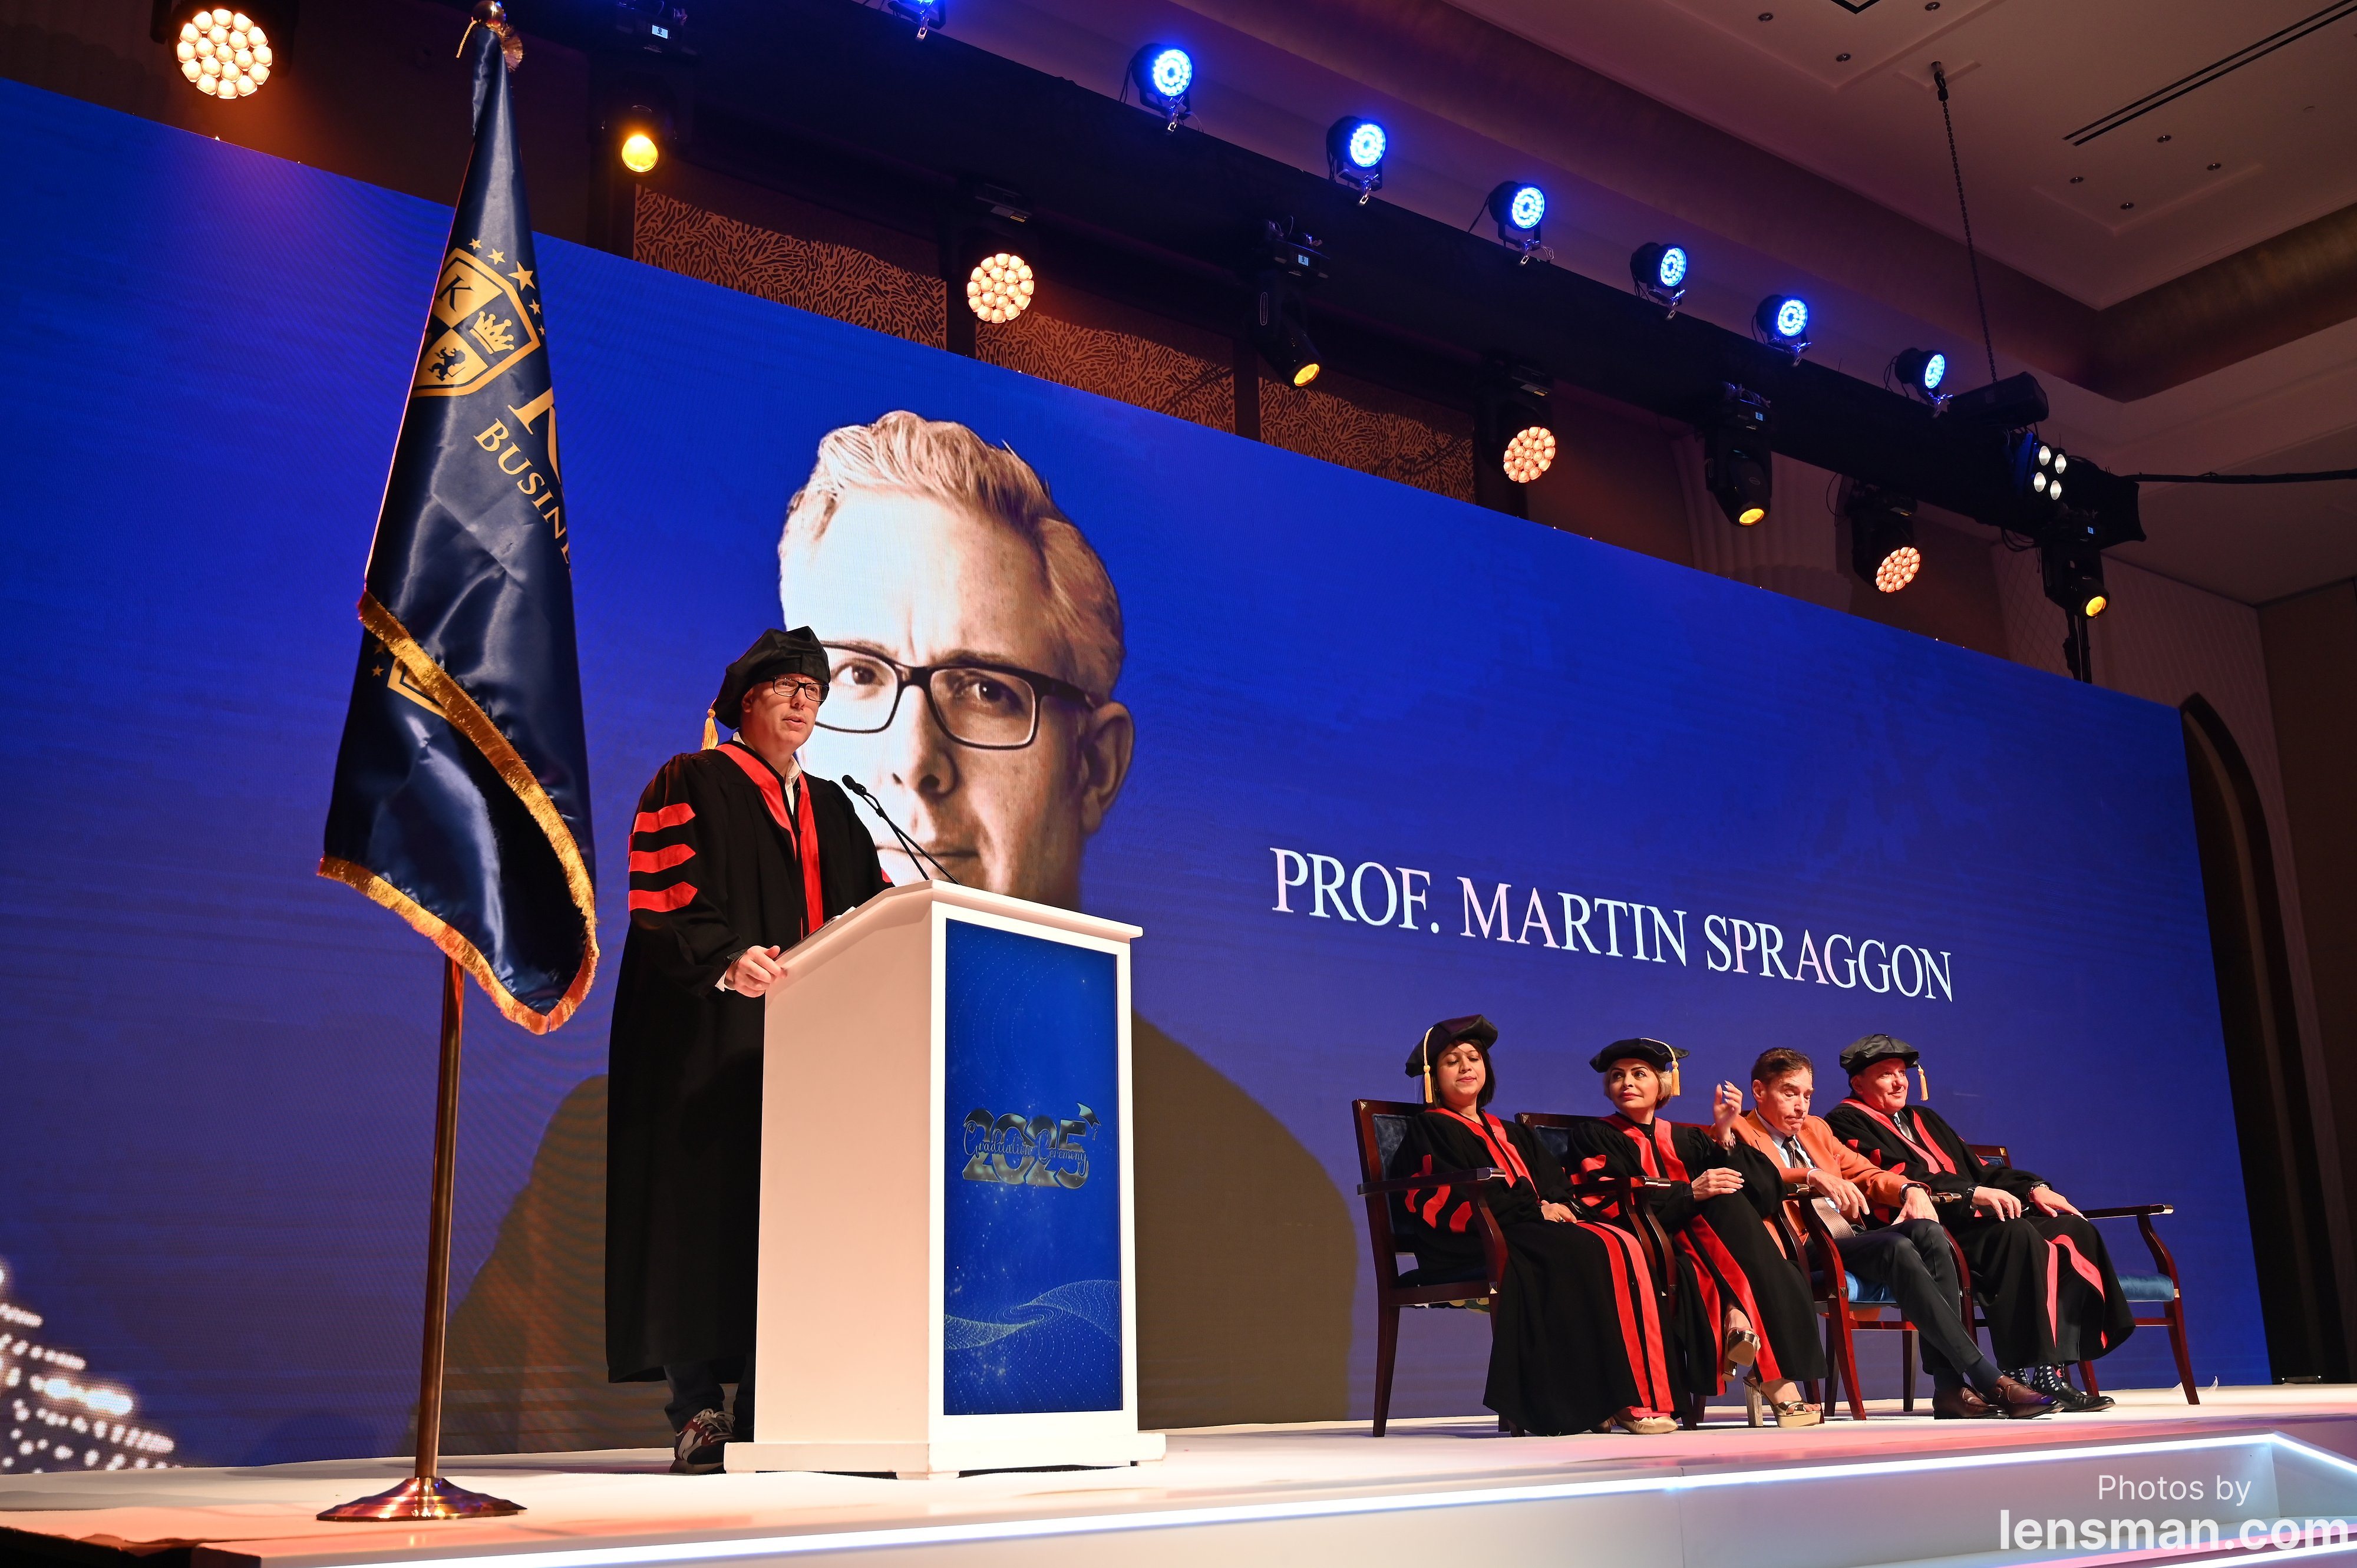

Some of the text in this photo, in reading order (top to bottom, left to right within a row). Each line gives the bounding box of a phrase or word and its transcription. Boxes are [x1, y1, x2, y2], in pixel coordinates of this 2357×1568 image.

[438, 274, 473, 312] K
[1269, 847, 1953, 1003] PROF. MARTIN SPRAGGON
[962, 1108, 1090, 1189] 2025
[963, 1120, 1088, 1179] Graduation Ceremony
